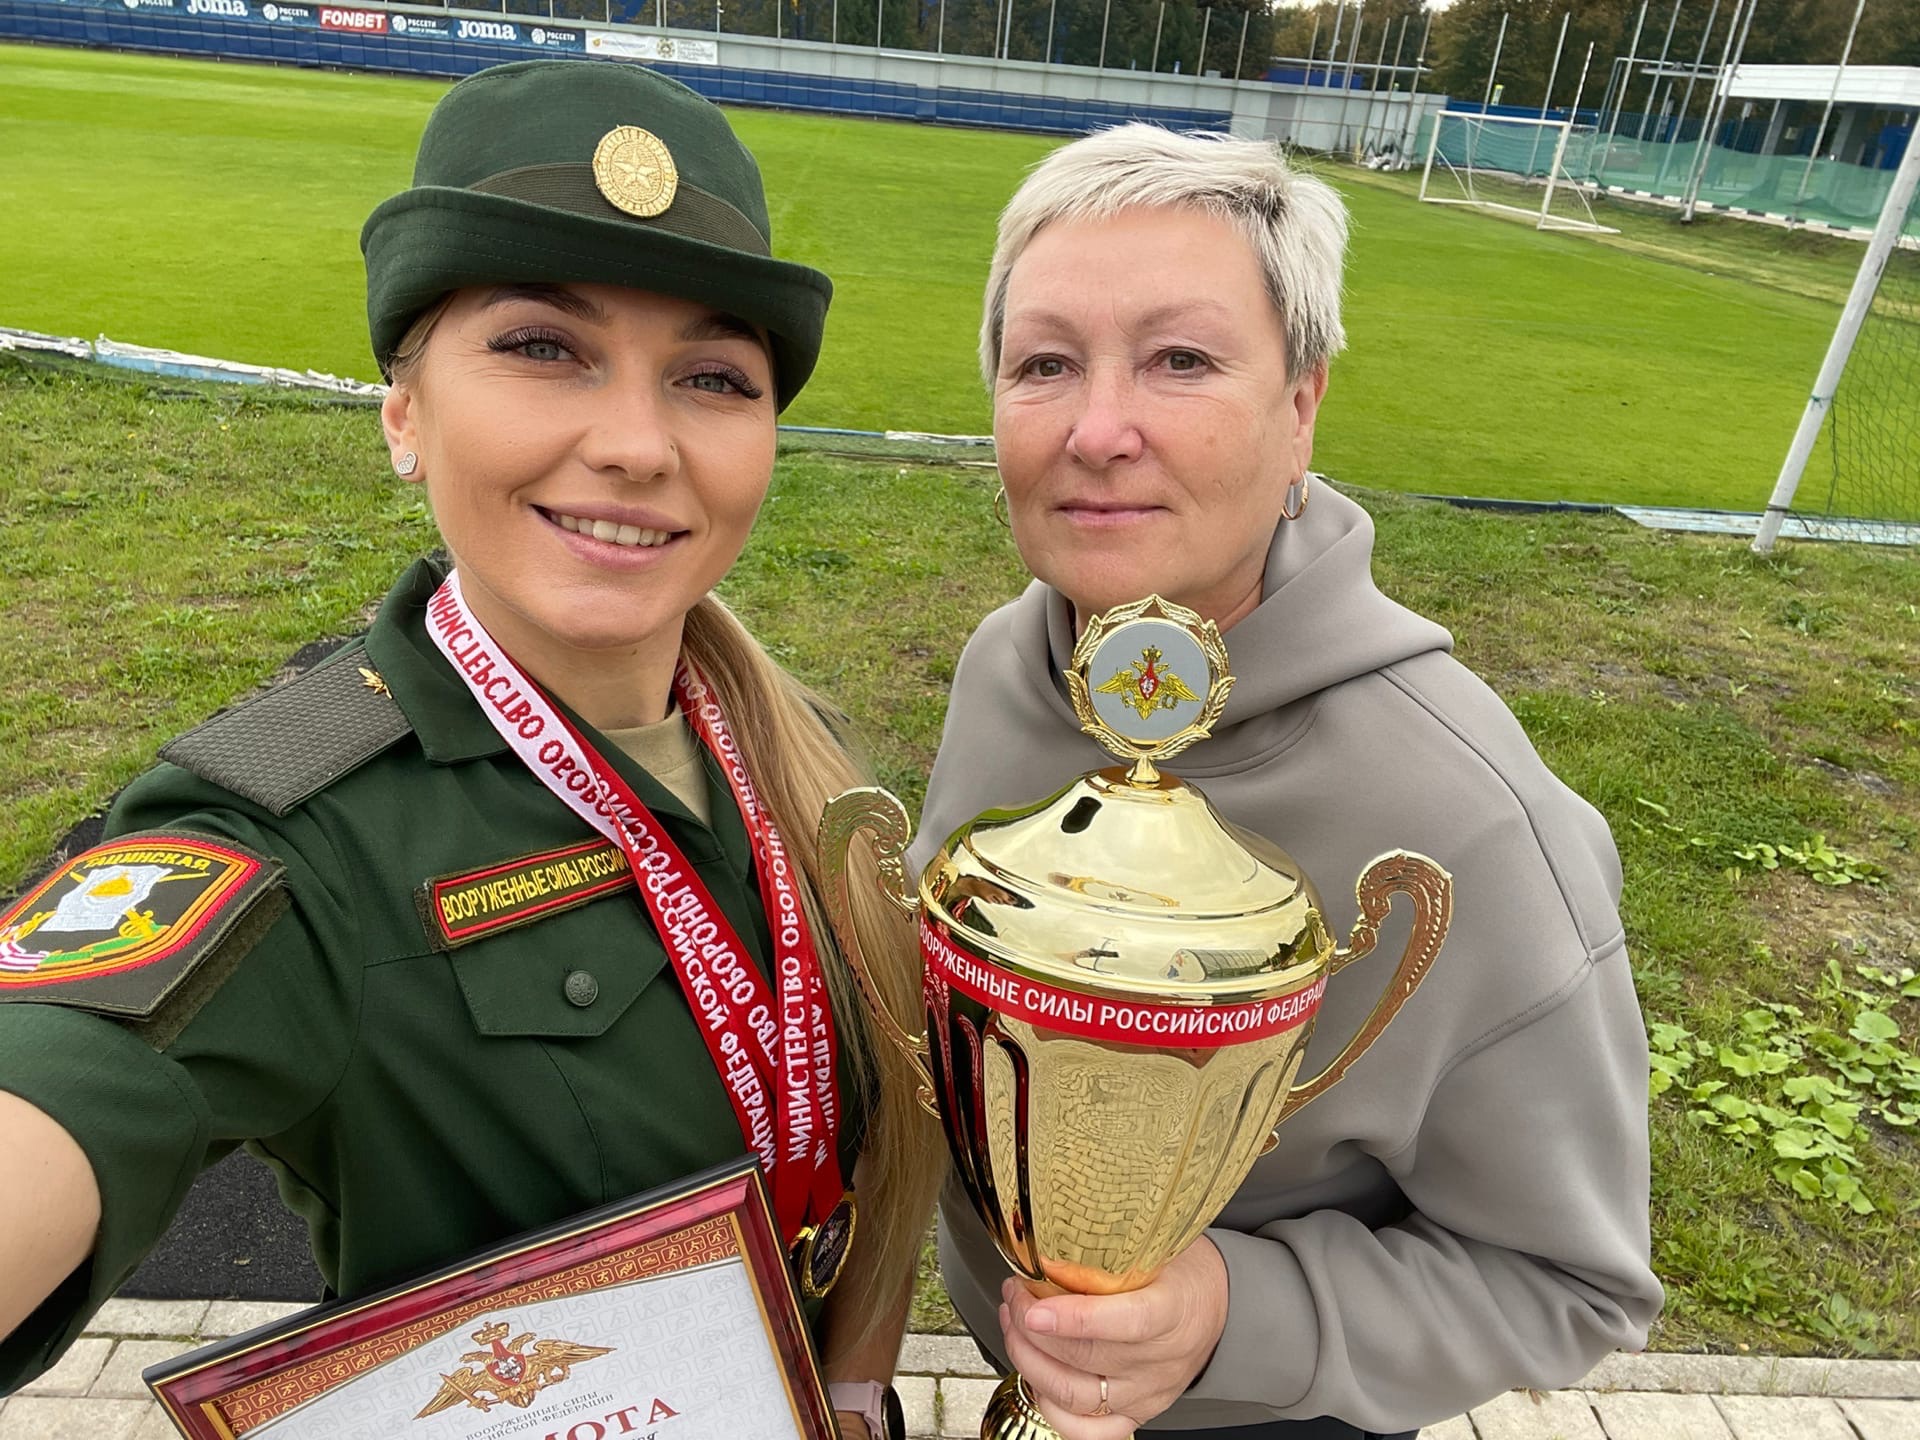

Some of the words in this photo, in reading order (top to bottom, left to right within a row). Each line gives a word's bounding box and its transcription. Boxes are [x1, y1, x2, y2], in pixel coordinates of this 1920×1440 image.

[321, 9, 386, 29] FONBET
[440, 869, 550, 924] ВООРУЖЕННЫЕ
[547, 860, 584, 890] СИЛЫ
[640, 857, 729, 1031] РОССИЙСКОЙ
[719, 1031, 778, 1174] ФЕДЕРАЦИИ
[1024, 986, 1093, 1025] СИЛЫ
[1099, 1003, 1264, 1035] РОССИЙСКОЙ
[781, 955, 808, 1163] МИНИСТЕРСТВО
[563, 1391, 600, 1409] СИЛЫ
